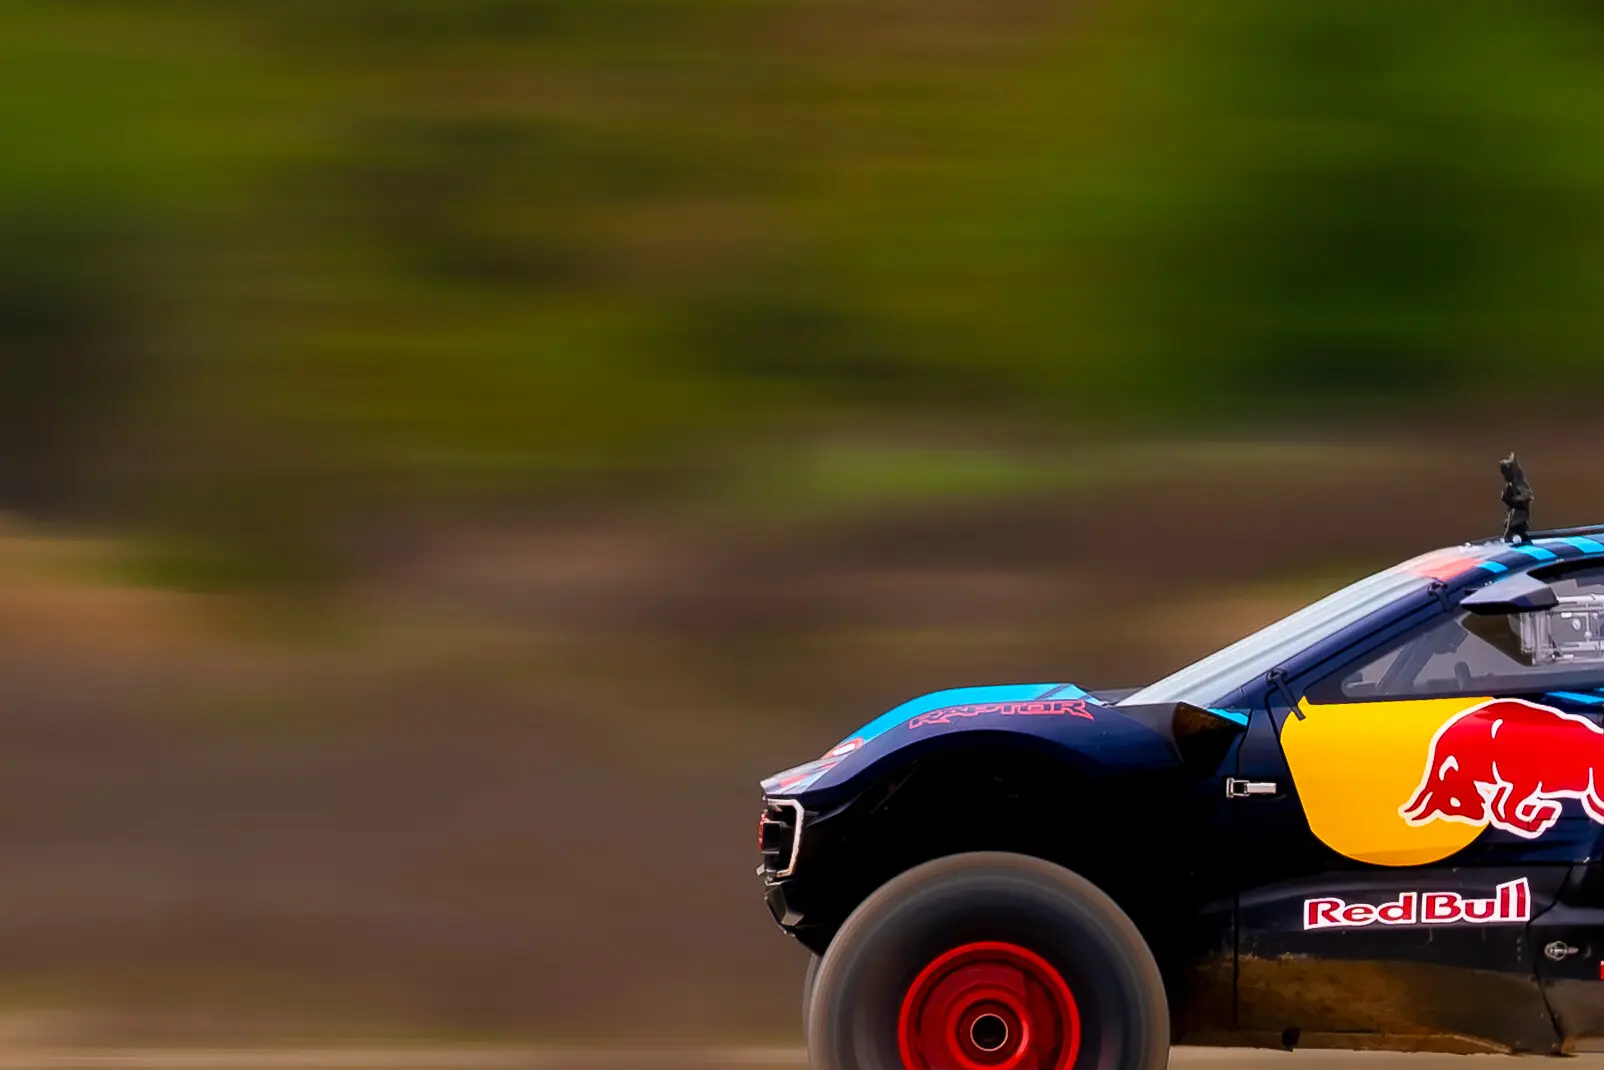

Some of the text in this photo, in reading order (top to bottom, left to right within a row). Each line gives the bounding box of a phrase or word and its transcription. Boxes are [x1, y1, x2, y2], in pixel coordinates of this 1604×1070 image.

[908, 700, 1094, 730] RAPTOR
[1303, 877, 1531, 930] Red Bull
